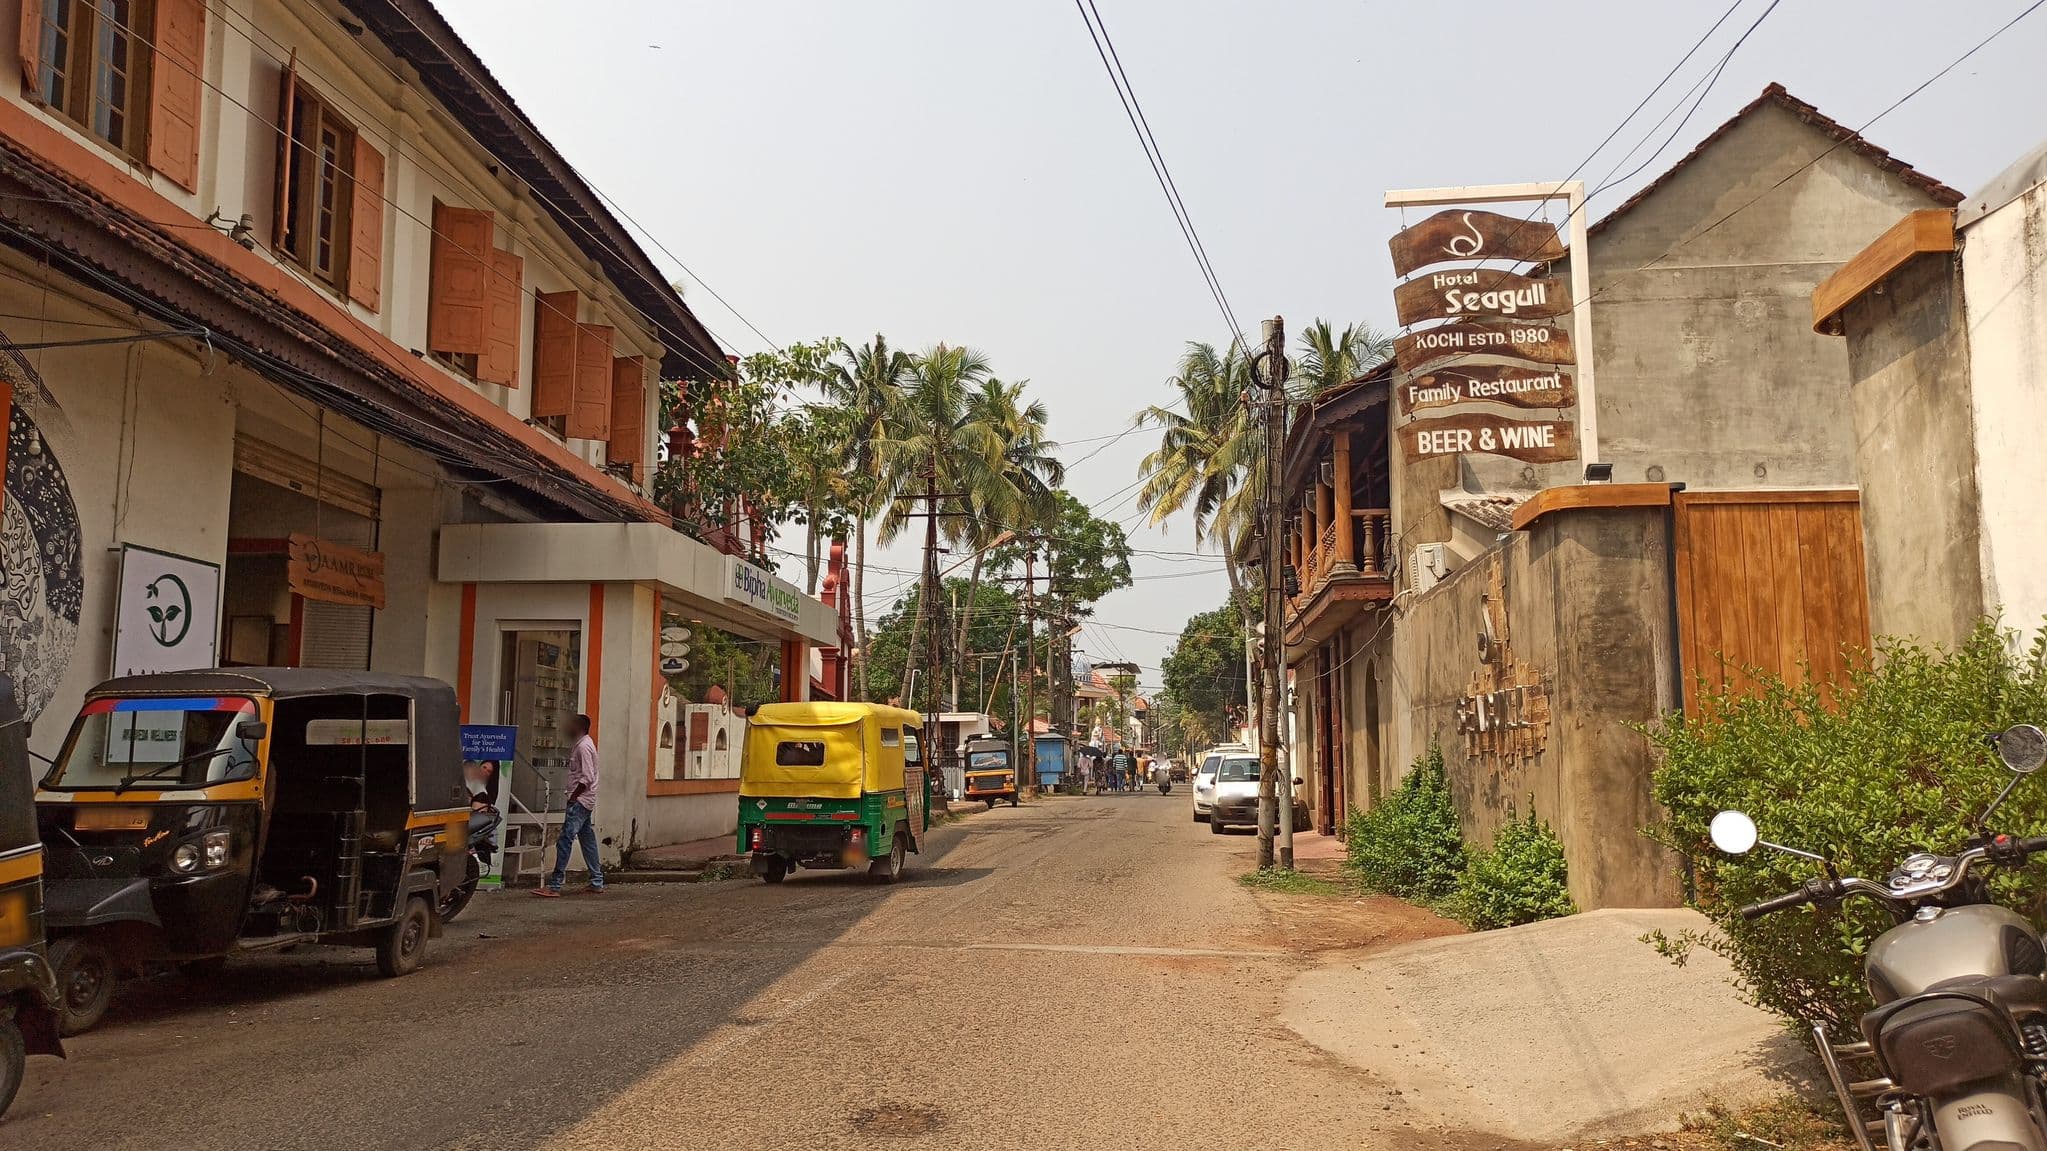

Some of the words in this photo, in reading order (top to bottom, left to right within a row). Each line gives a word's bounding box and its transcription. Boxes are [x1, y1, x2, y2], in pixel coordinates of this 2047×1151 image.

[1433, 272, 1478, 289] Hotel
[1445, 283, 1546, 314] Seagull
[1416, 332, 1463, 349] KOCHI
[1469, 332, 1507, 346] ESTD.
[1511, 328, 1549, 344] 1980
[1409, 382, 1460, 403] Family
[1468, 373, 1562, 398] Restaurant
[1417, 428, 1473, 454] BEER
[1478, 427, 1496, 451] &
[1499, 425, 1556, 449] WINE
[744, 567, 765, 602] Bipha
[767, 578, 799, 614] Ayurveda
[1957, 1104, 1986, 1113] ROYAL
[1957, 1109, 1992, 1120] ENFIELD
